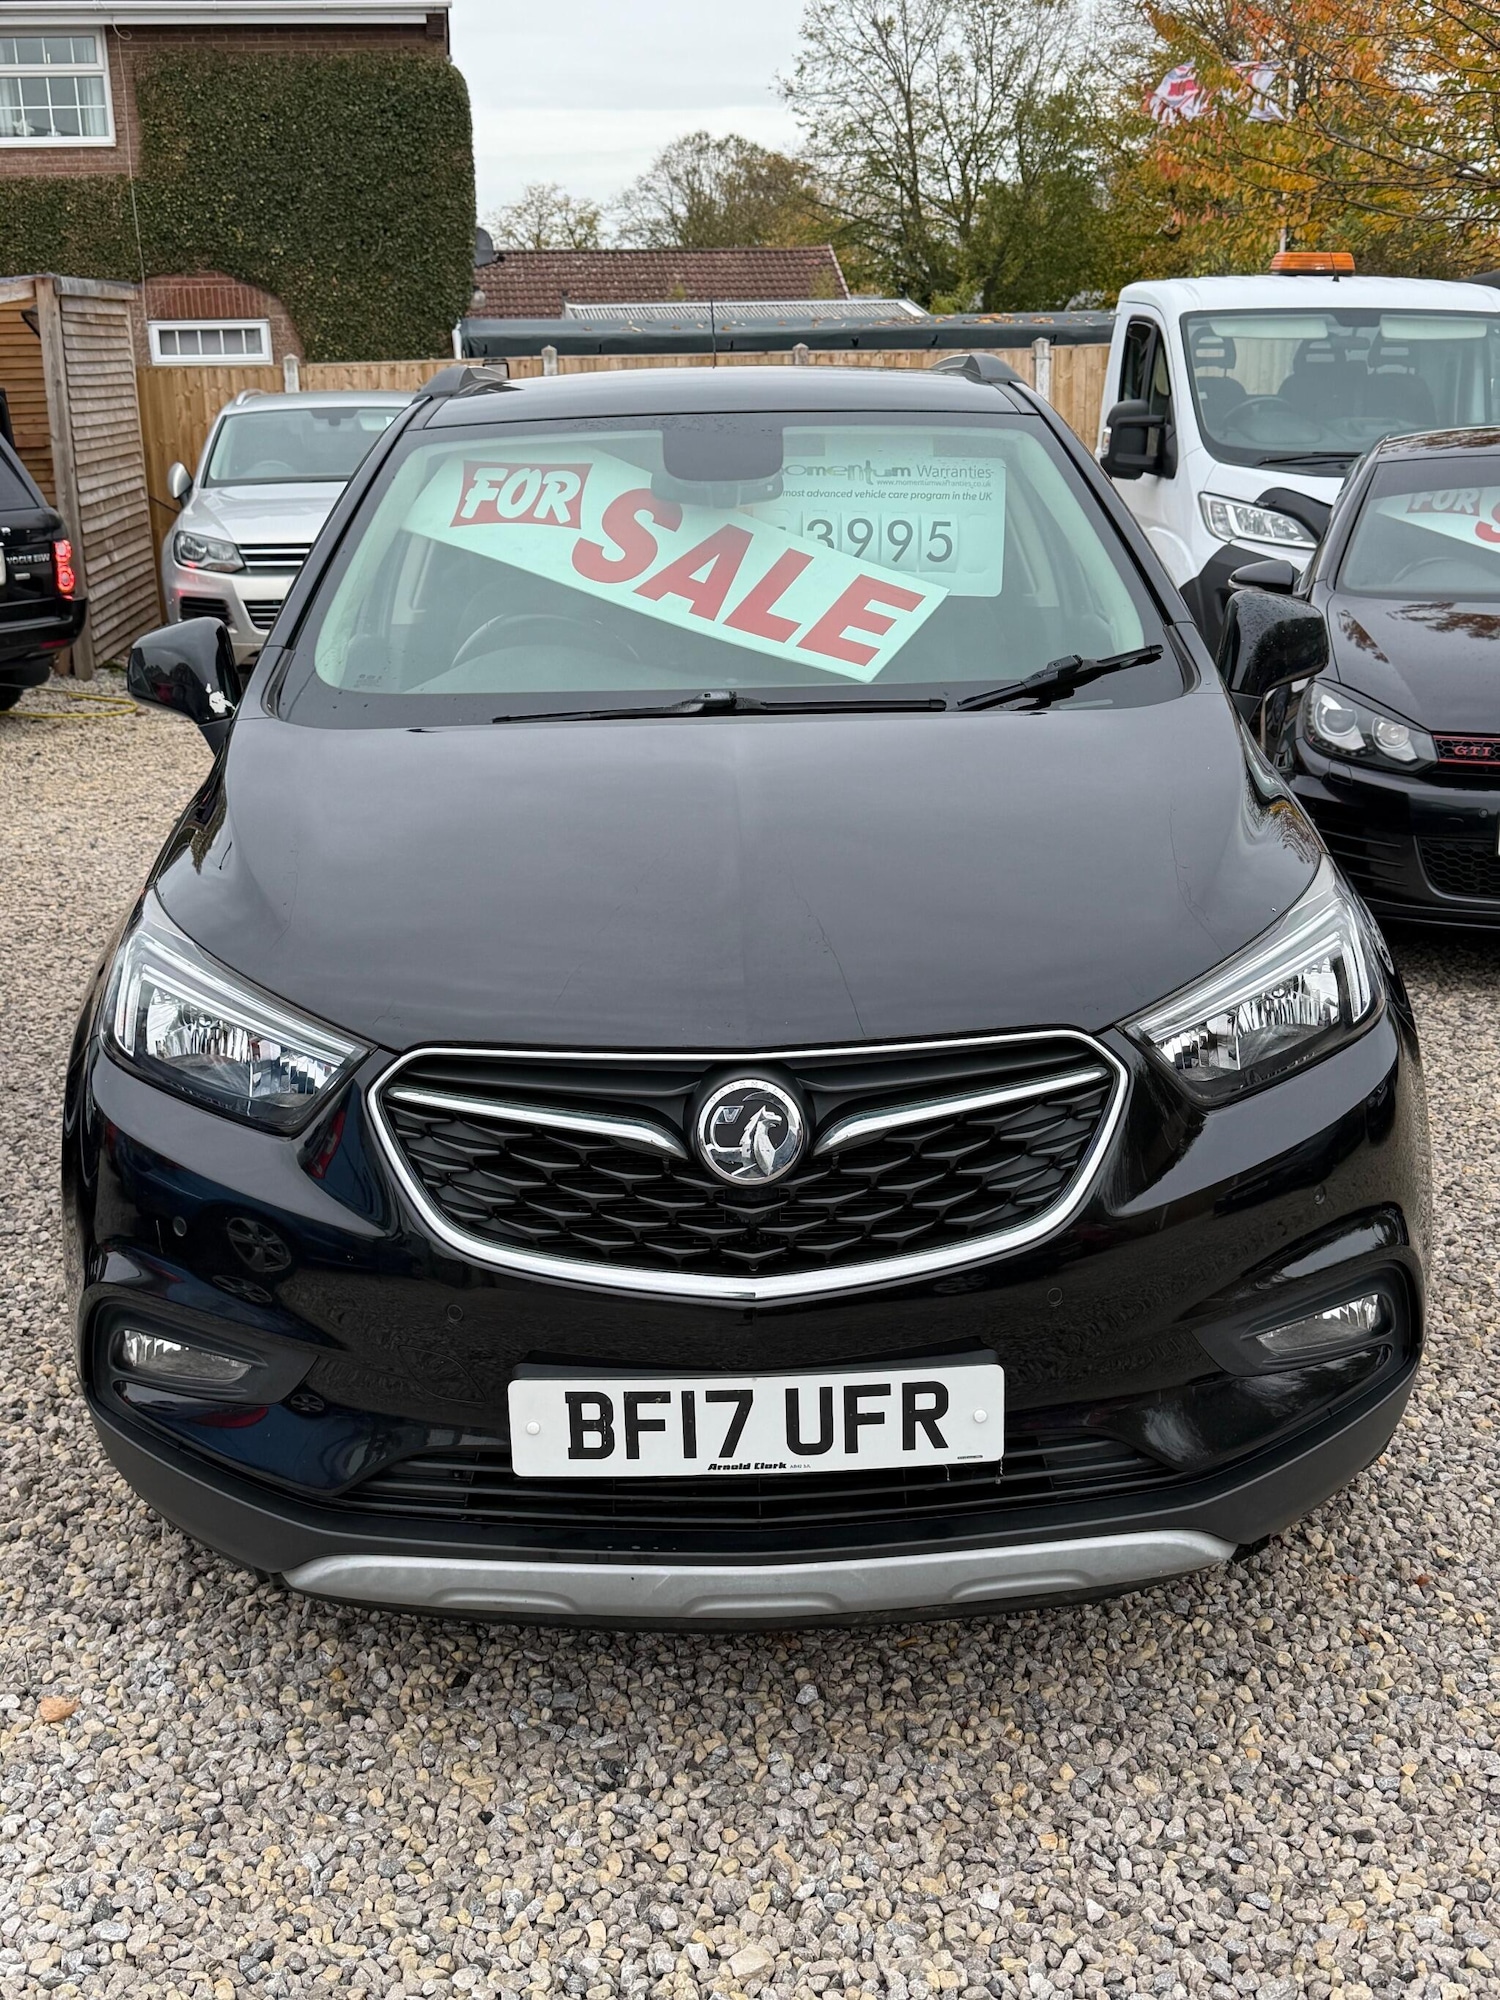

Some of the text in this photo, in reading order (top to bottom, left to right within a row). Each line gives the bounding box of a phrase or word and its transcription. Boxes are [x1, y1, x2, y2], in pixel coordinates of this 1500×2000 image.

[777, 460, 992, 486] omentum Warranties
[783, 488, 993, 502] most advanced vehicle care program in the UK
[1411, 489, 1480, 514] FOR
[776, 518, 954, 563] 3995
[460, 467, 926, 667] FOR SALE
[1453, 745, 1492, 757] GTI
[564, 1380, 949, 1460] BF17 UFR
